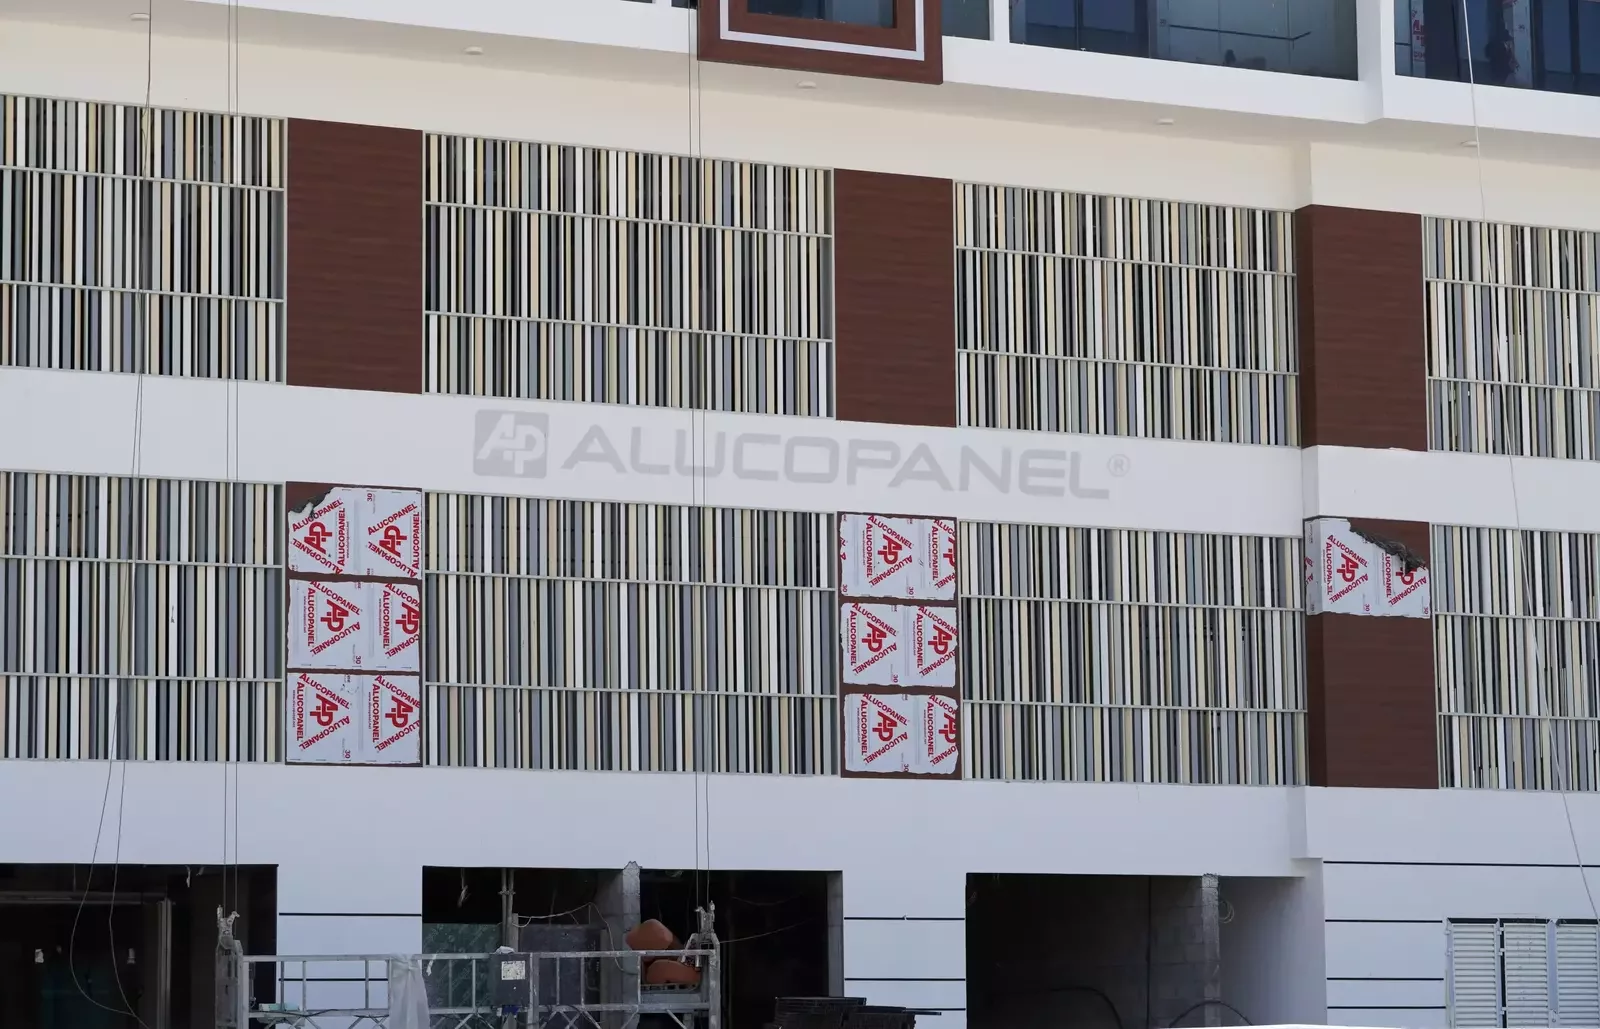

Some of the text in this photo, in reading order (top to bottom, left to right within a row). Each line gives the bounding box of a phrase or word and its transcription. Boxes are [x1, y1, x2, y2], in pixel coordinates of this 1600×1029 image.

[473, 409, 549, 479] AP
[562, 422, 1110, 500] ALUCOPANEL
[367, 492, 373, 502] 30
[292, 499, 343, 532] ALUCOPANEL
[367, 502, 418, 536] ALUCOPANEL
[868, 514, 913, 549] ALUCOPANEL
[304, 521, 332, 555] AP
[337, 508, 346, 567] ALUCOPANEL
[379, 525, 407, 558] AP
[411, 511, 420, 570] ALUCOPANEL
[877, 534, 902, 565] AP
[1327, 534, 1368, 568] ALUCOPANEL
[292, 538, 343, 575] ALUCOPANEL
[367, 541, 418, 578] ALUCOPANEL
[869, 555, 913, 587] ALUCOPANEL
[1336, 553, 1359, 583] AP
[310, 580, 360, 615] ALUCOPANEL
[842, 584, 848, 593] 30
[908, 586, 914, 596] 30
[1329, 573, 1369, 604] ALUCOPANEL
[1388, 576, 1427, 607] ALUCOPANEL
[307, 587, 316, 647] ALUCOPANEL
[320, 599, 349, 632] AP
[382, 590, 391, 649] ALUCOPANEL
[395, 602, 420, 635] AP
[852, 602, 897, 637] ALUCOPANEL
[310, 621, 361, 656] ALUCOPANEL
[862, 621, 887, 653] AP
[928, 624, 952, 655] AP
[355, 655, 362, 665] 30
[852, 642, 897, 675] ALUCOPANEL
[299, 672, 350, 709] ALUCOPANEL
[297, 681, 305, 741] ALUCOPANEL
[310, 693, 338, 726] AP
[372, 683, 380, 743] ALUCOPANEL
[385, 695, 413, 728] AP
[863, 693, 908, 726] ALUCOPANEL
[299, 715, 351, 750] ALUCOPANEL
[872, 711, 897, 742] AP
[344, 749, 351, 759] 30
[863, 732, 908, 764] ALUCOPANEL
